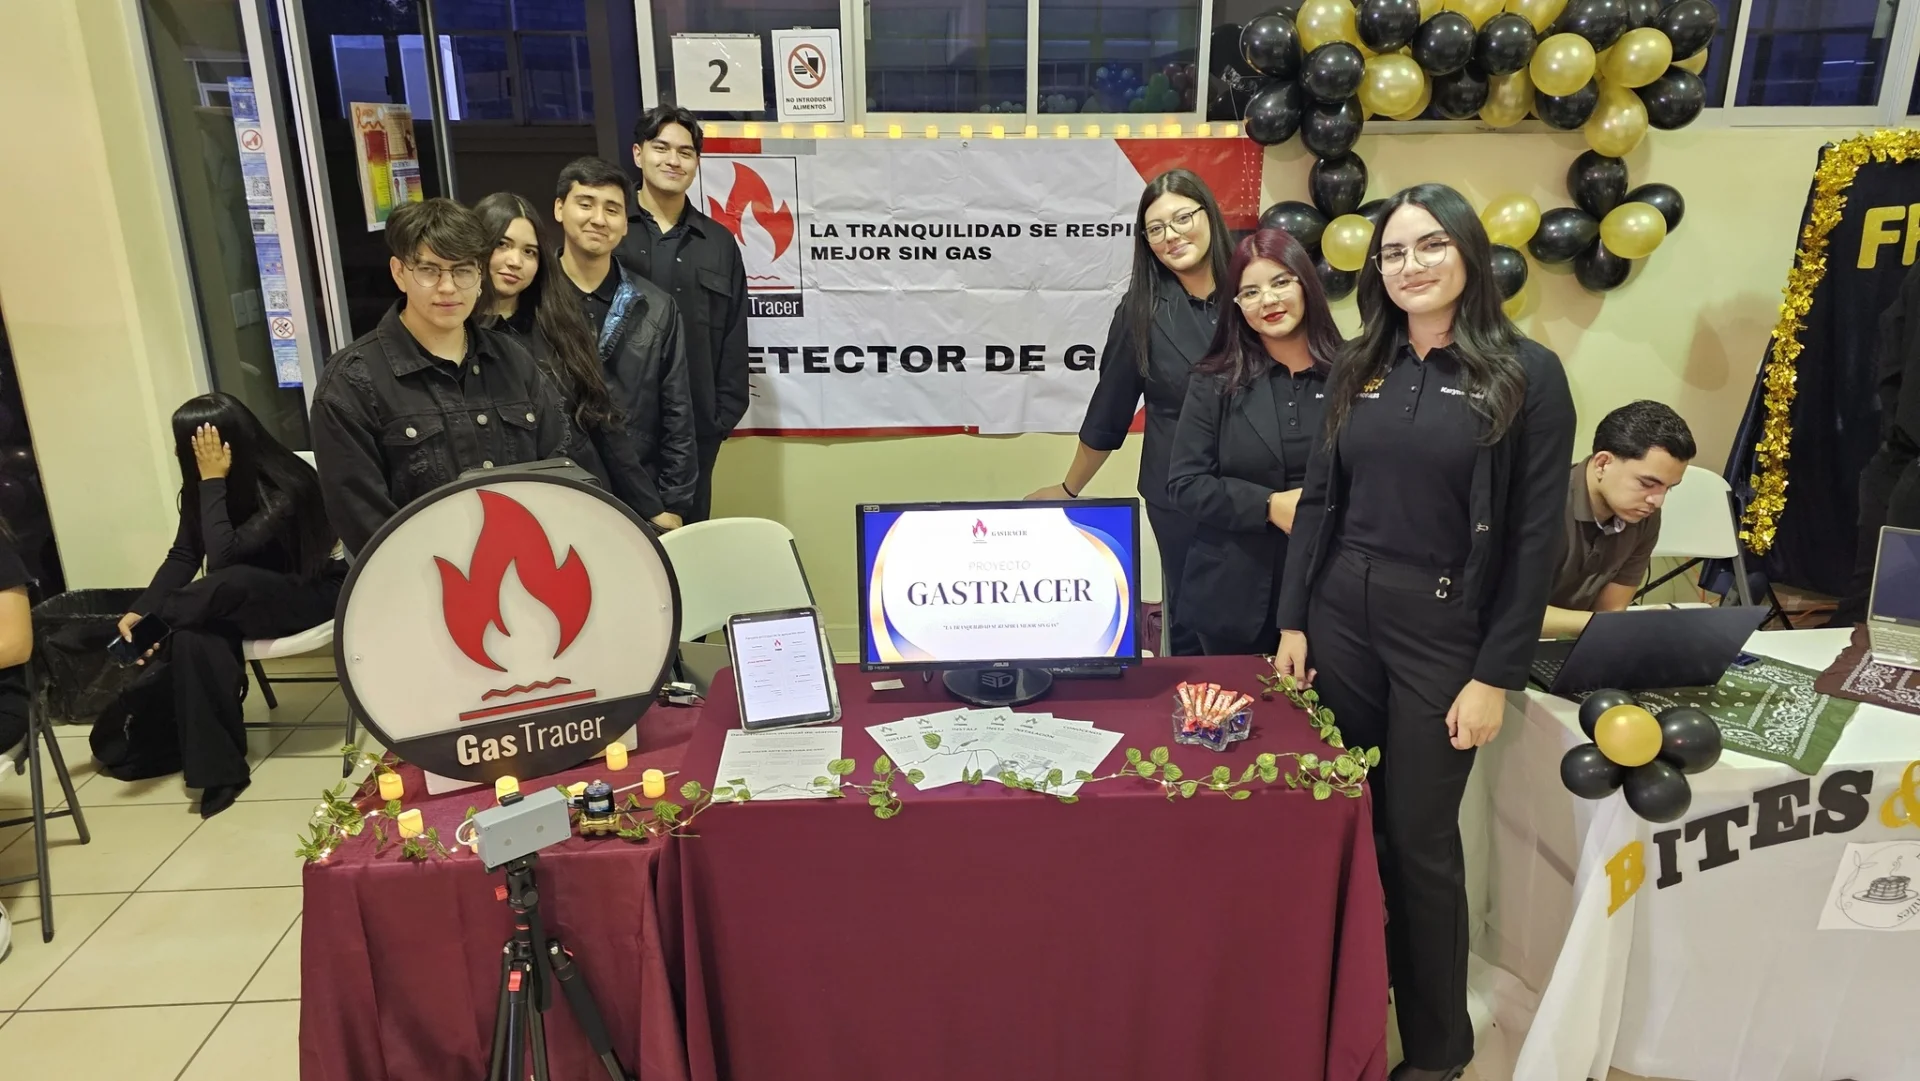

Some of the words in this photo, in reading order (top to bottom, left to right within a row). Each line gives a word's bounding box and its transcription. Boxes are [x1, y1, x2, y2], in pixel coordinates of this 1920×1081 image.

[708, 59, 731, 93] 2
[810, 223, 839, 238] LA
[846, 223, 1021, 240] TRANQUILIDAD
[1029, 223, 1058, 238] SE
[1066, 222, 1136, 238] RESPI
[810, 246, 891, 261] MEJOR
[898, 246, 937, 261] SIN
[945, 246, 992, 261] GAS
[747, 296, 800, 315] Tracer
[748, 345, 967, 375] ETECTOR
[985, 344, 1046, 373] DE
[968, 560, 1032, 571] PROYECTO
[907, 578, 1093, 606] GASTRACER
[1604, 769, 1873, 918] BITES
